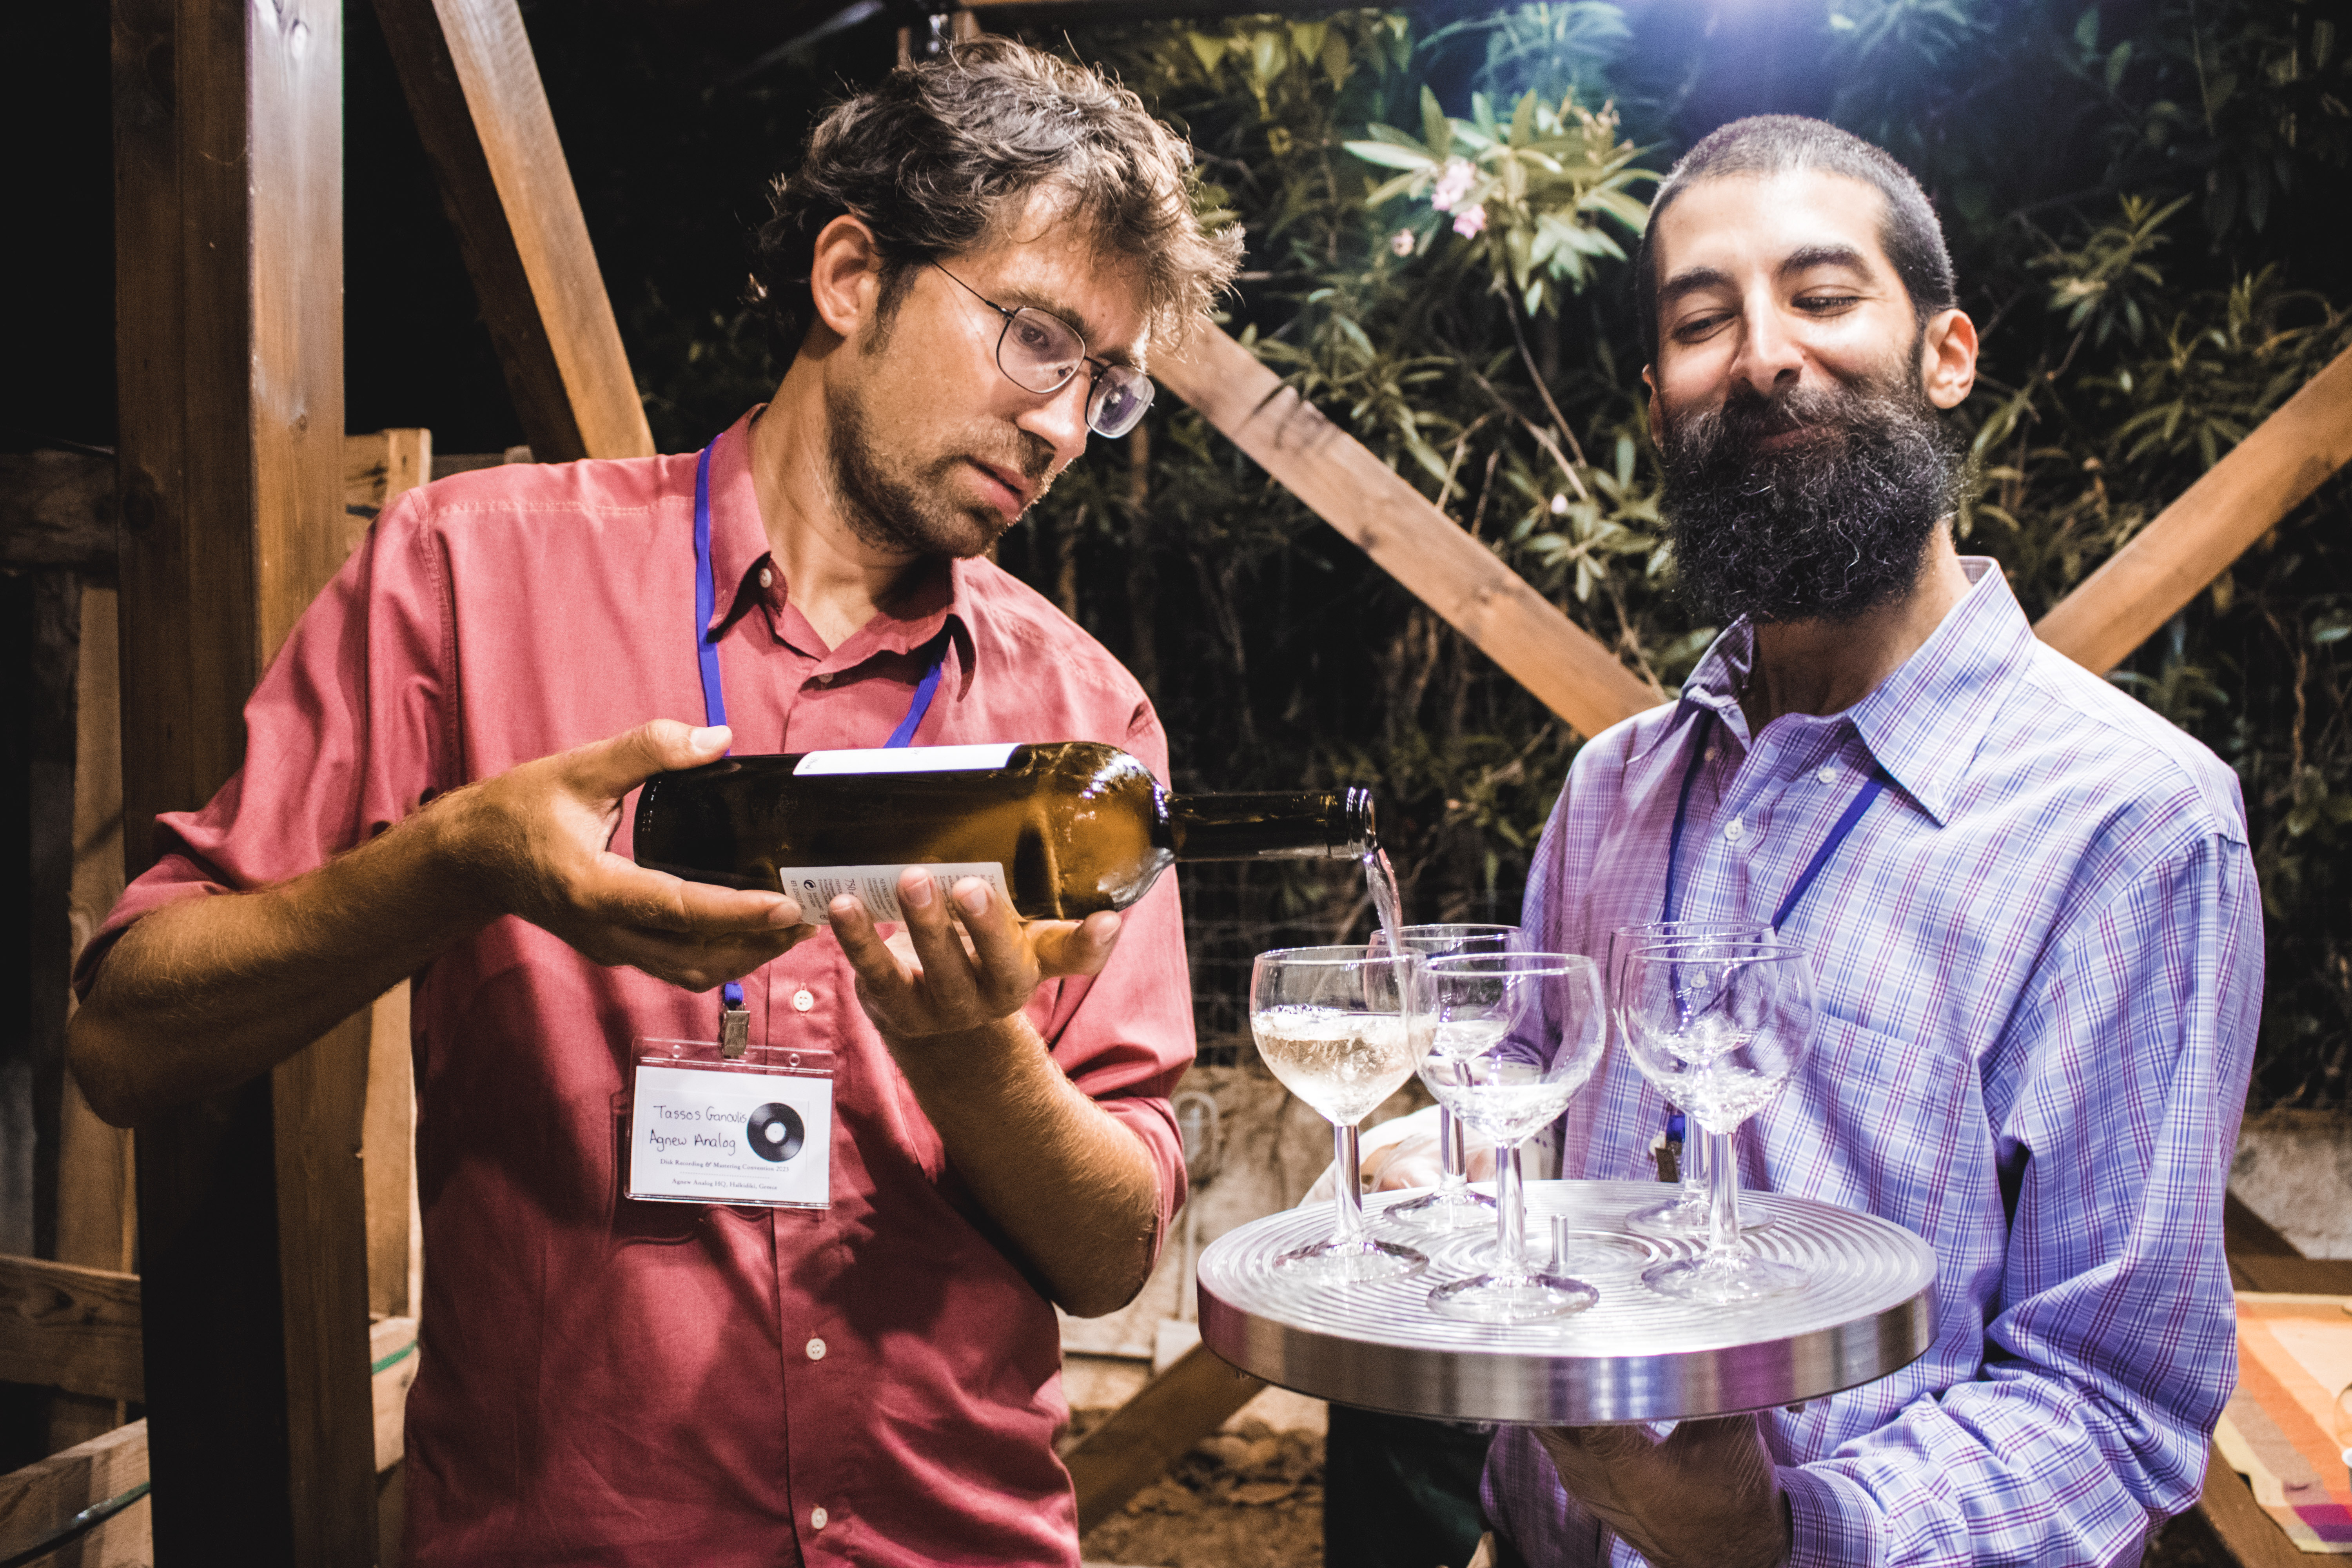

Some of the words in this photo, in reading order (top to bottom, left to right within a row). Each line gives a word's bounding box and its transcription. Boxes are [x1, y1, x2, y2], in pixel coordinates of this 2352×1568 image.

[653, 1105, 701, 1120] Tassos
[650, 1129, 687, 1152] Agnew
[694, 1132, 735, 1156] Analog
[675, 1160, 703, 1168] Recording
